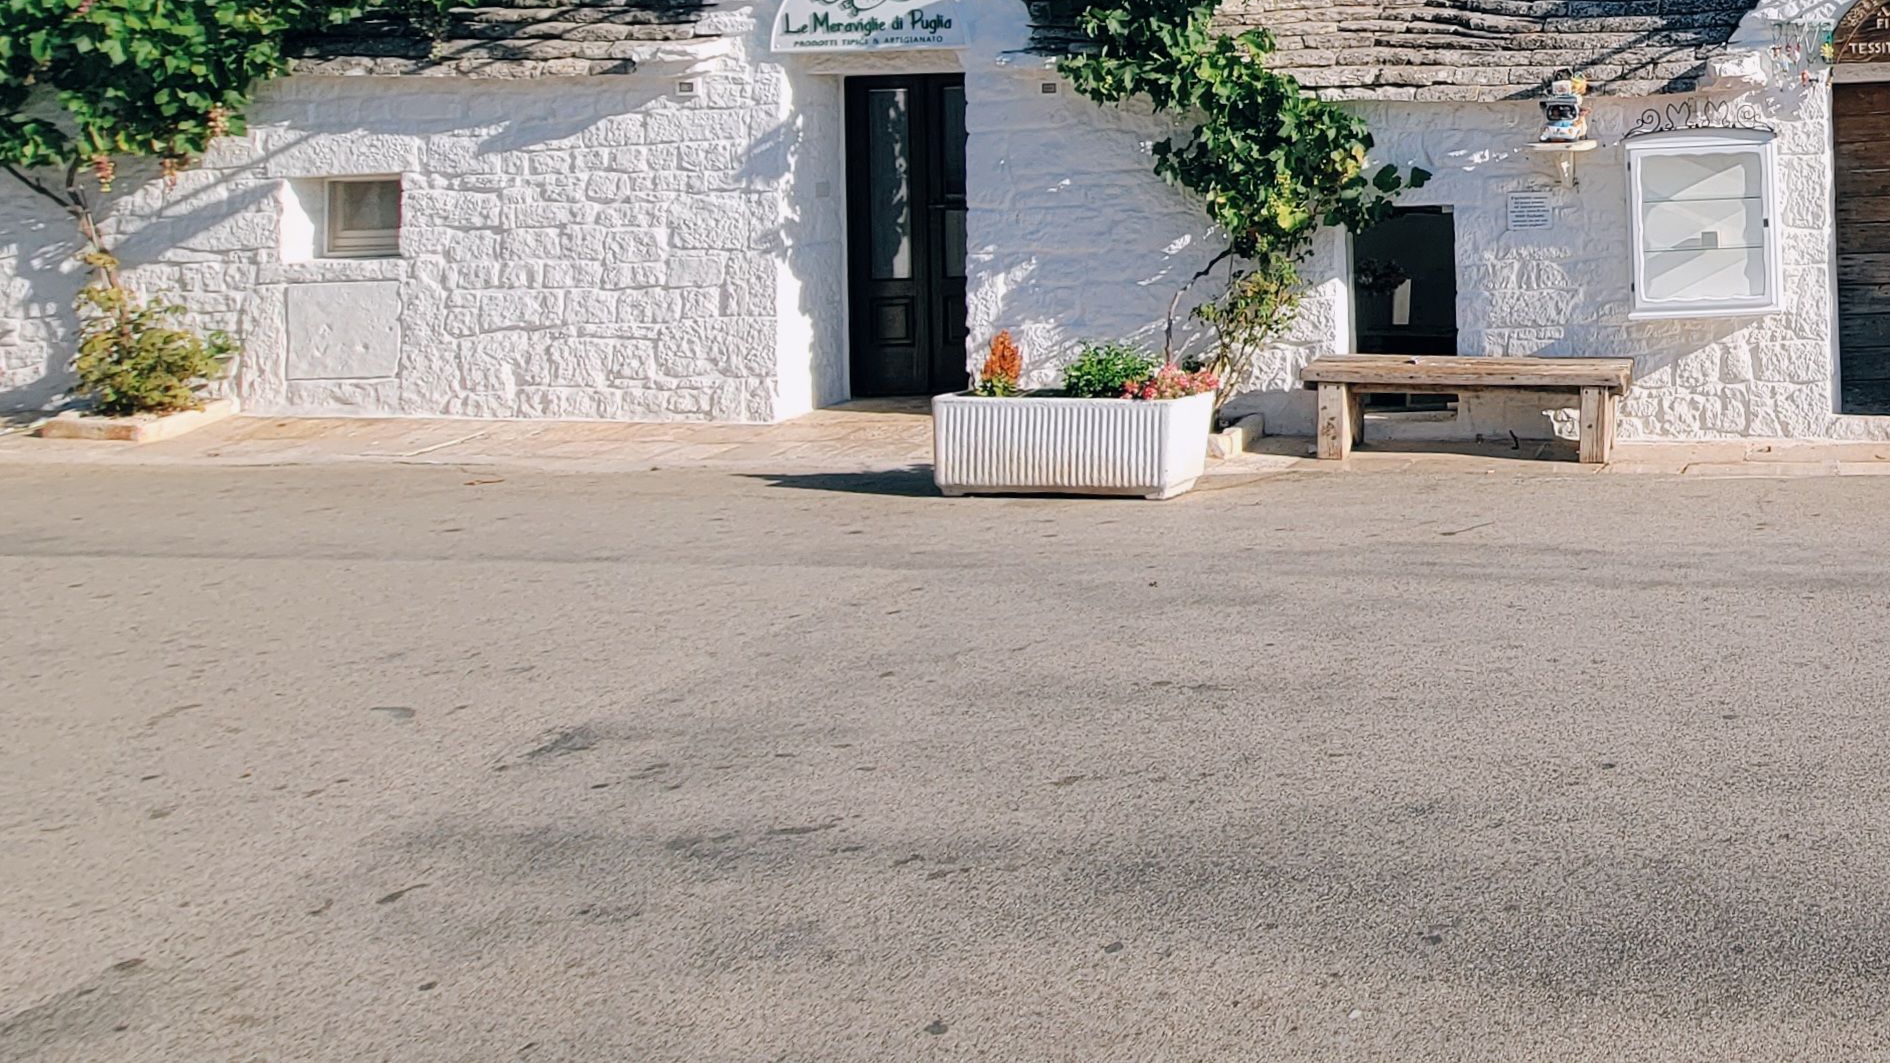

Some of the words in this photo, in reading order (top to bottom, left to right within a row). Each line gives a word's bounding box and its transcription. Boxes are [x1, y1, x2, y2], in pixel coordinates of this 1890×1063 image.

[784, 12, 808, 34] Le
[812, 11, 886, 37] Meraviglie
[891, 16, 903, 31] di
[908, 9, 952, 34] Puglia
[793, 40, 838, 48] PRODOTTI
[841, 38, 868, 46] TIPICI
[884, 35, 943, 44] ARTIGIANATO
